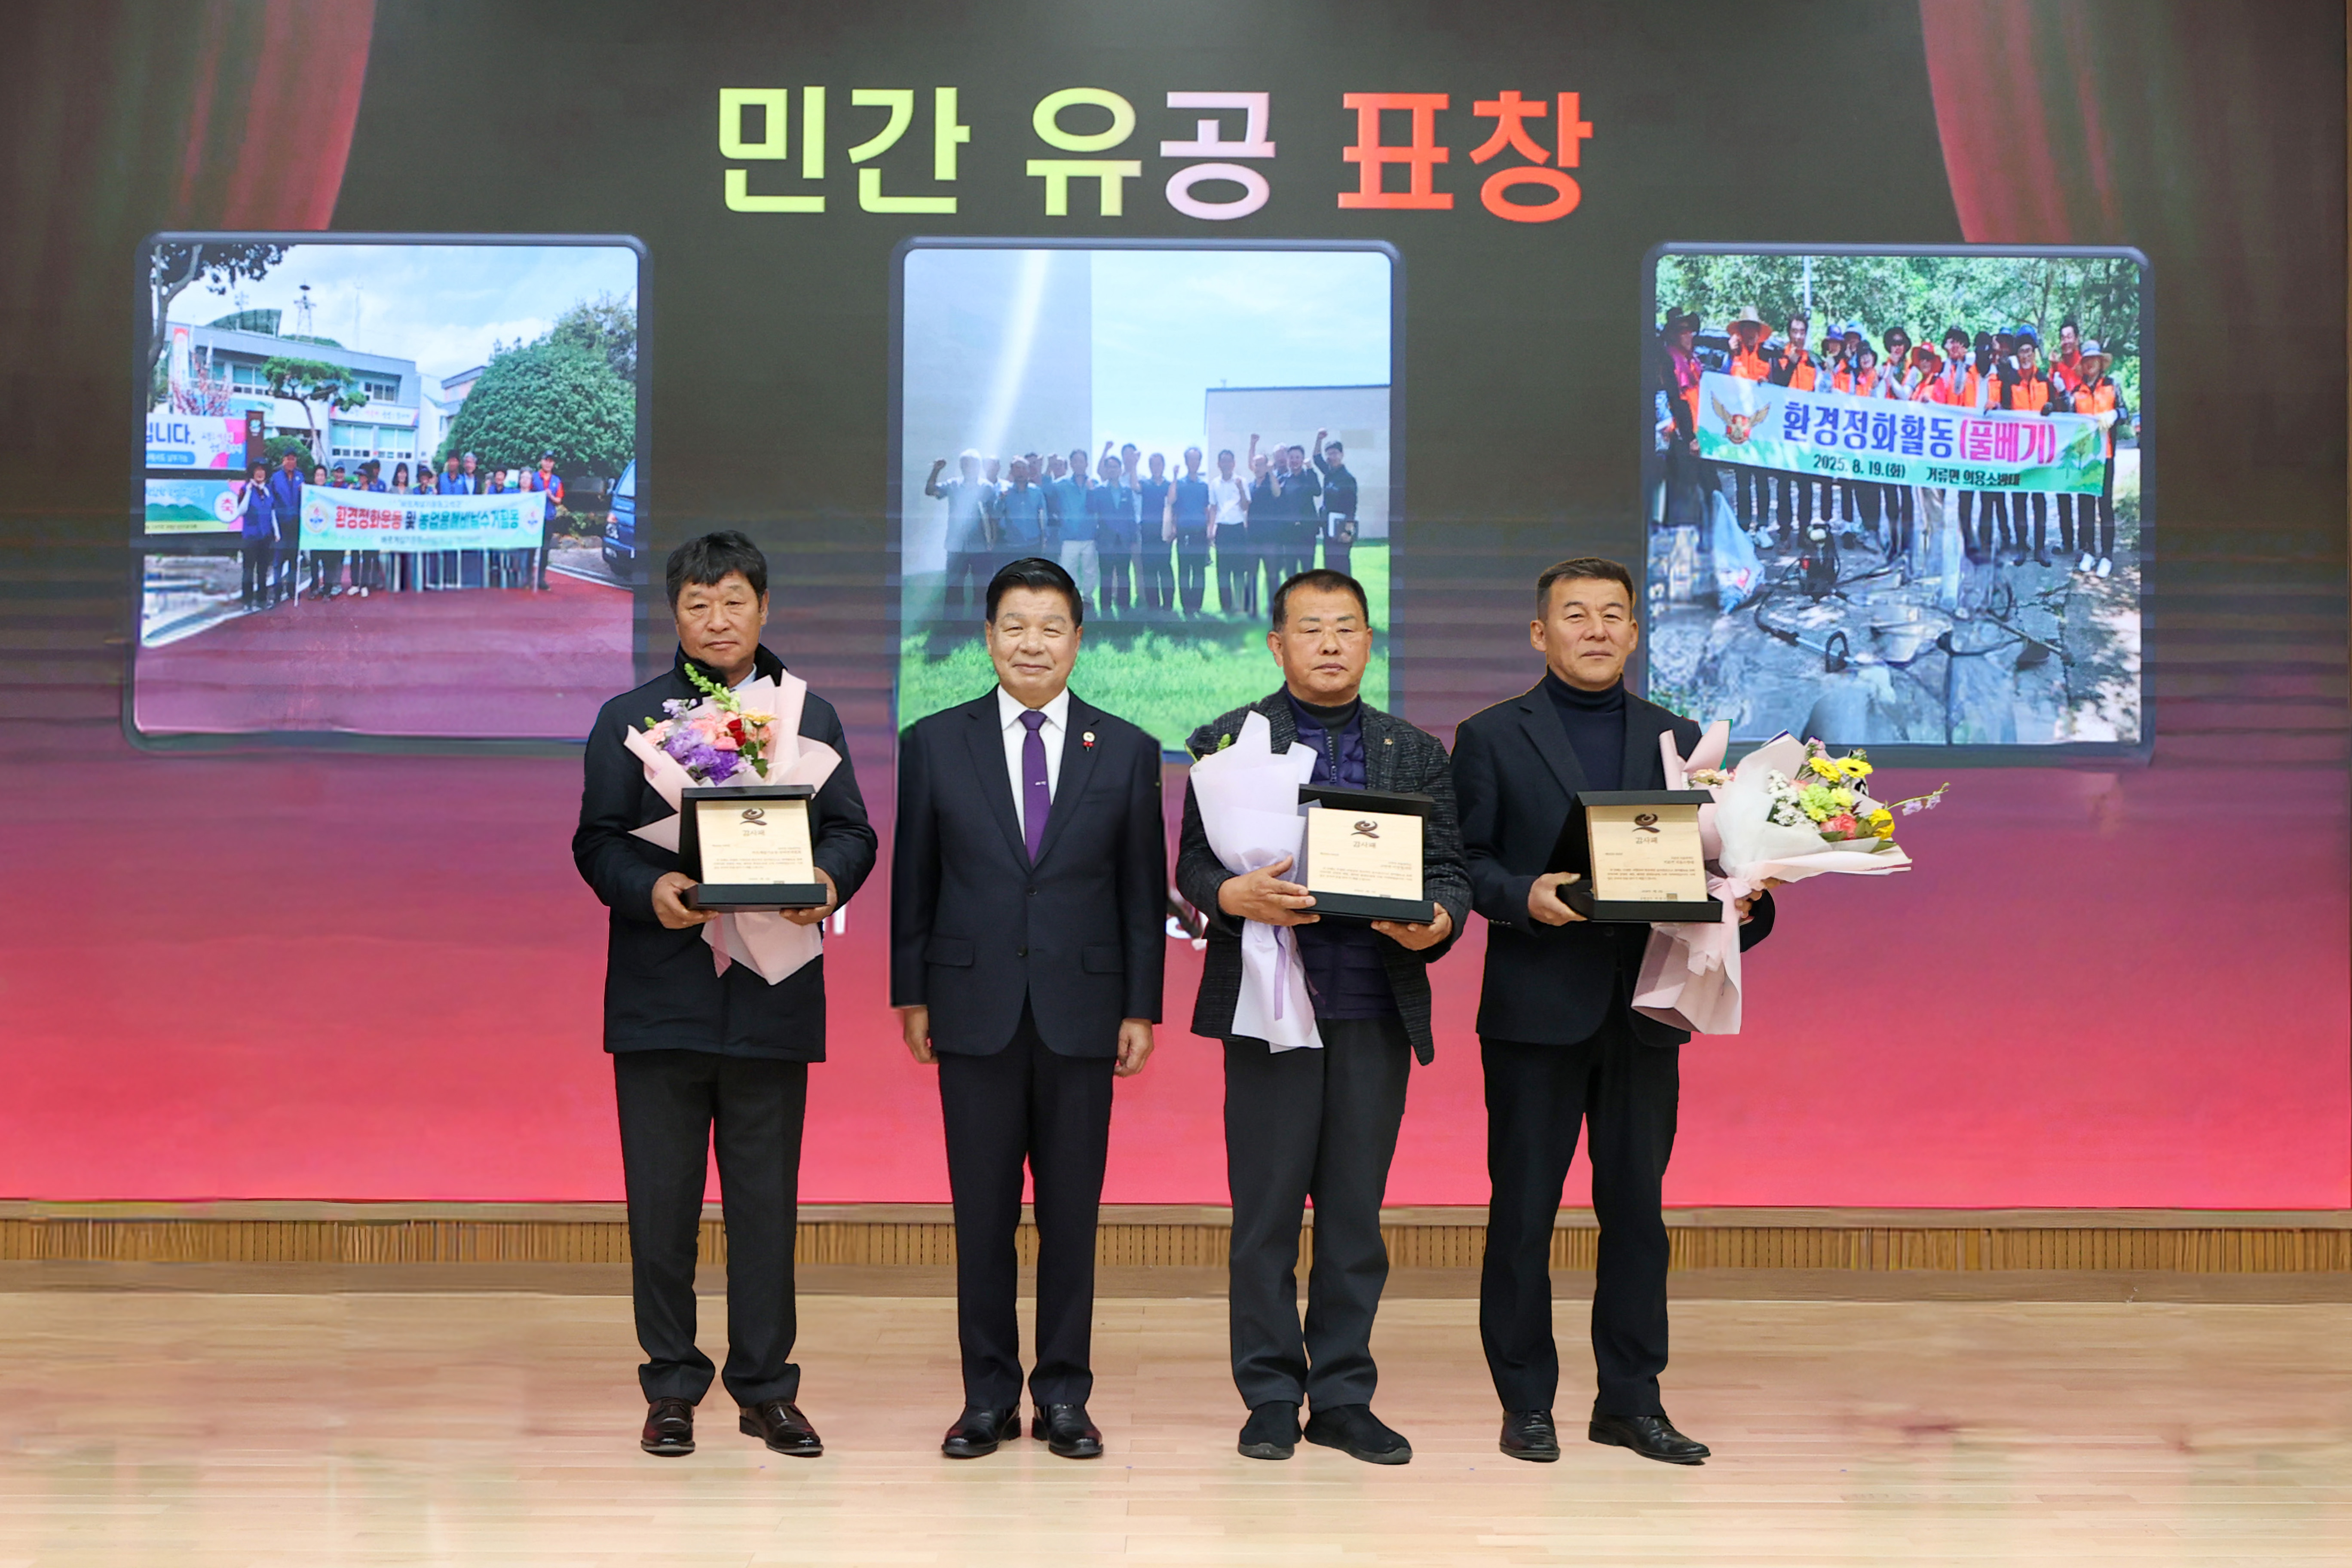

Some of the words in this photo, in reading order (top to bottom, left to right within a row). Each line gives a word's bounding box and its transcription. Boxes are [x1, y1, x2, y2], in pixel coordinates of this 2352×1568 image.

[719, 86, 971, 214] 민간
[1026, 87, 1277, 221] 유공
[1337, 90, 1594, 223] 표창
[1813, 453, 1848, 472] 2025.
[1852, 458, 1864, 474] 8.
[1926, 466, 1960, 484] 거류면
[220, 498, 234, 515] 축
[335, 505, 402, 530] 환경정화운동
[405, 511, 416, 530] 및
